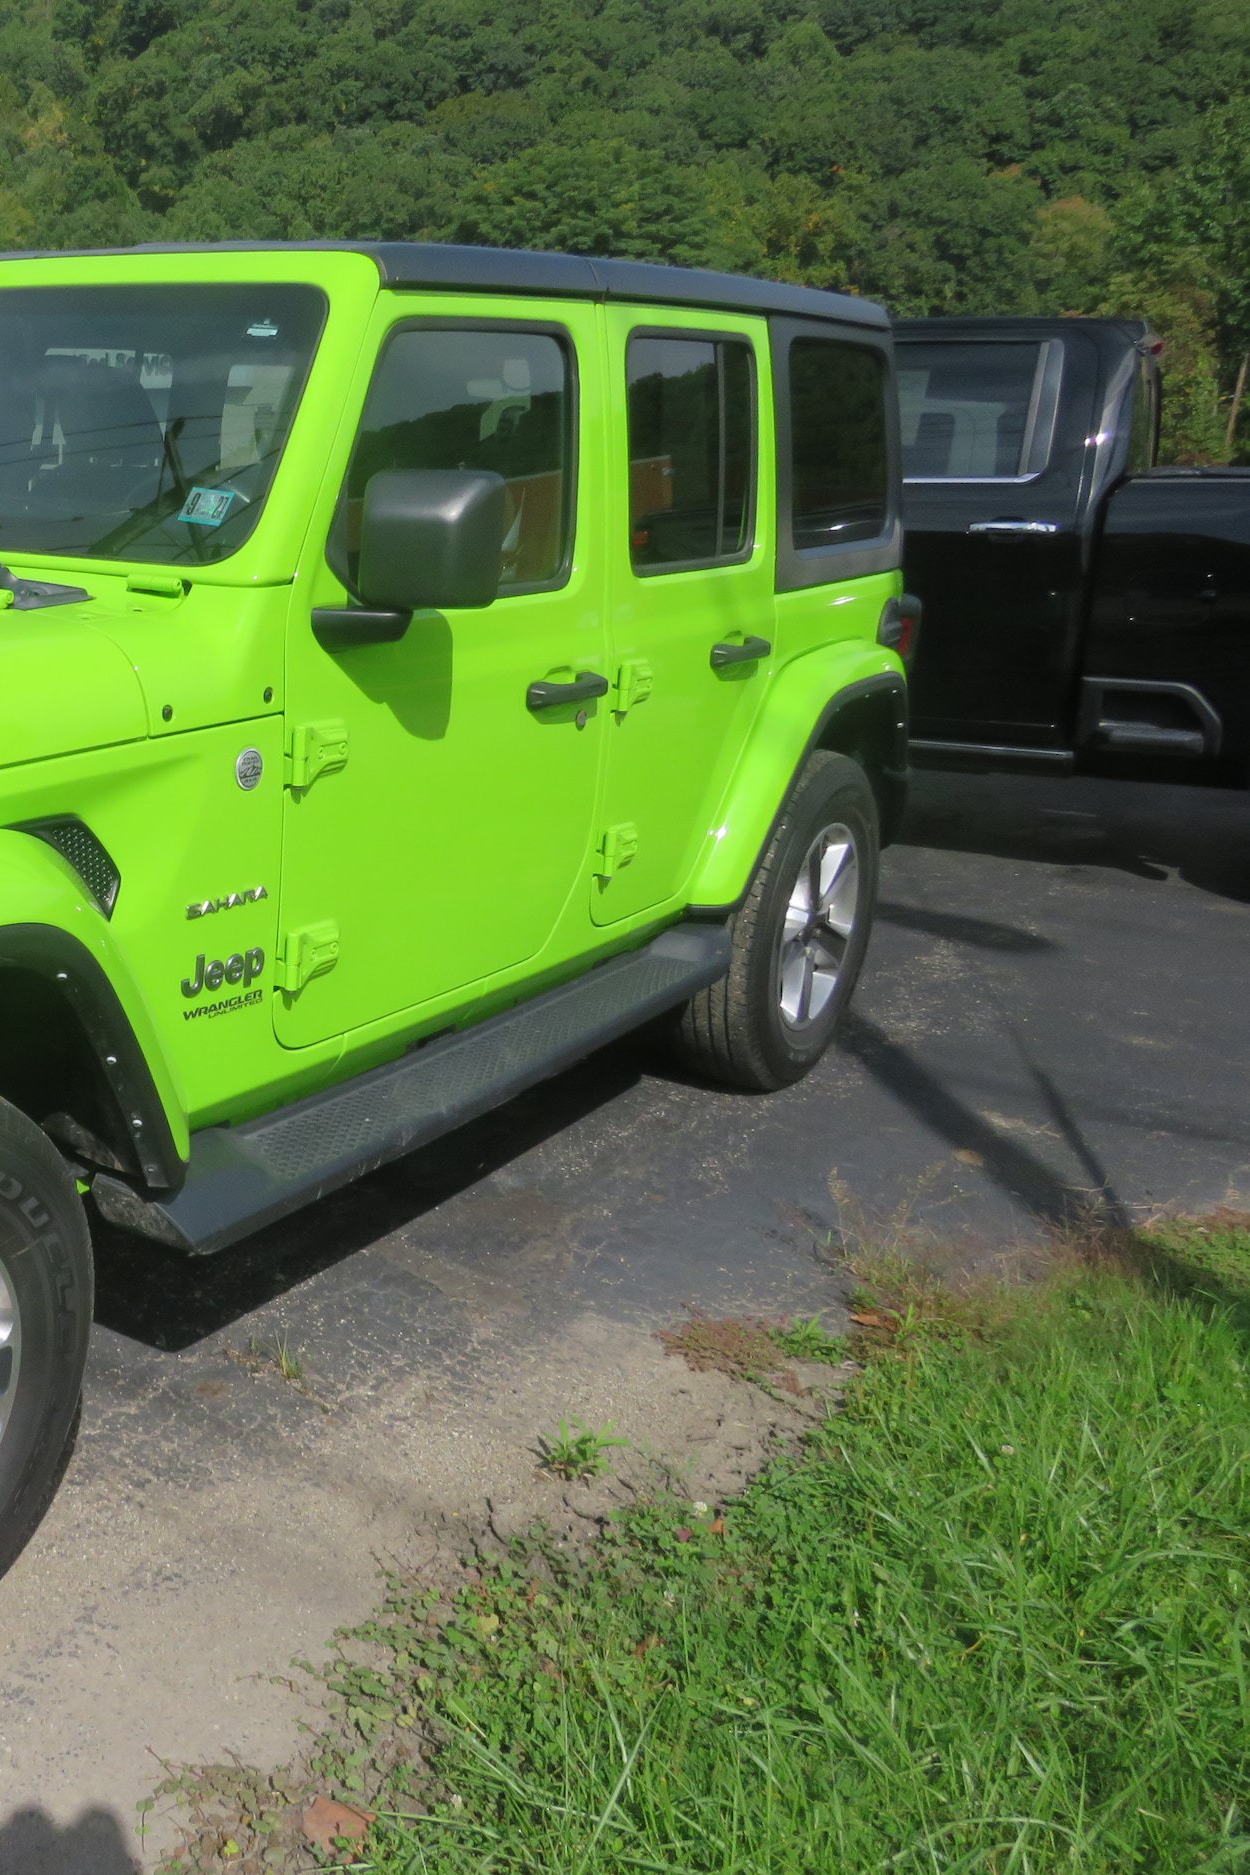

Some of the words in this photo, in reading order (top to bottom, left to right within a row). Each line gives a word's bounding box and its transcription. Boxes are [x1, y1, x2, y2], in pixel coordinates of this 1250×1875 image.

[186, 886, 268, 921] SAHARA
[180, 947, 265, 999] Jeep
[183, 989, 263, 1021] WRANGLER
